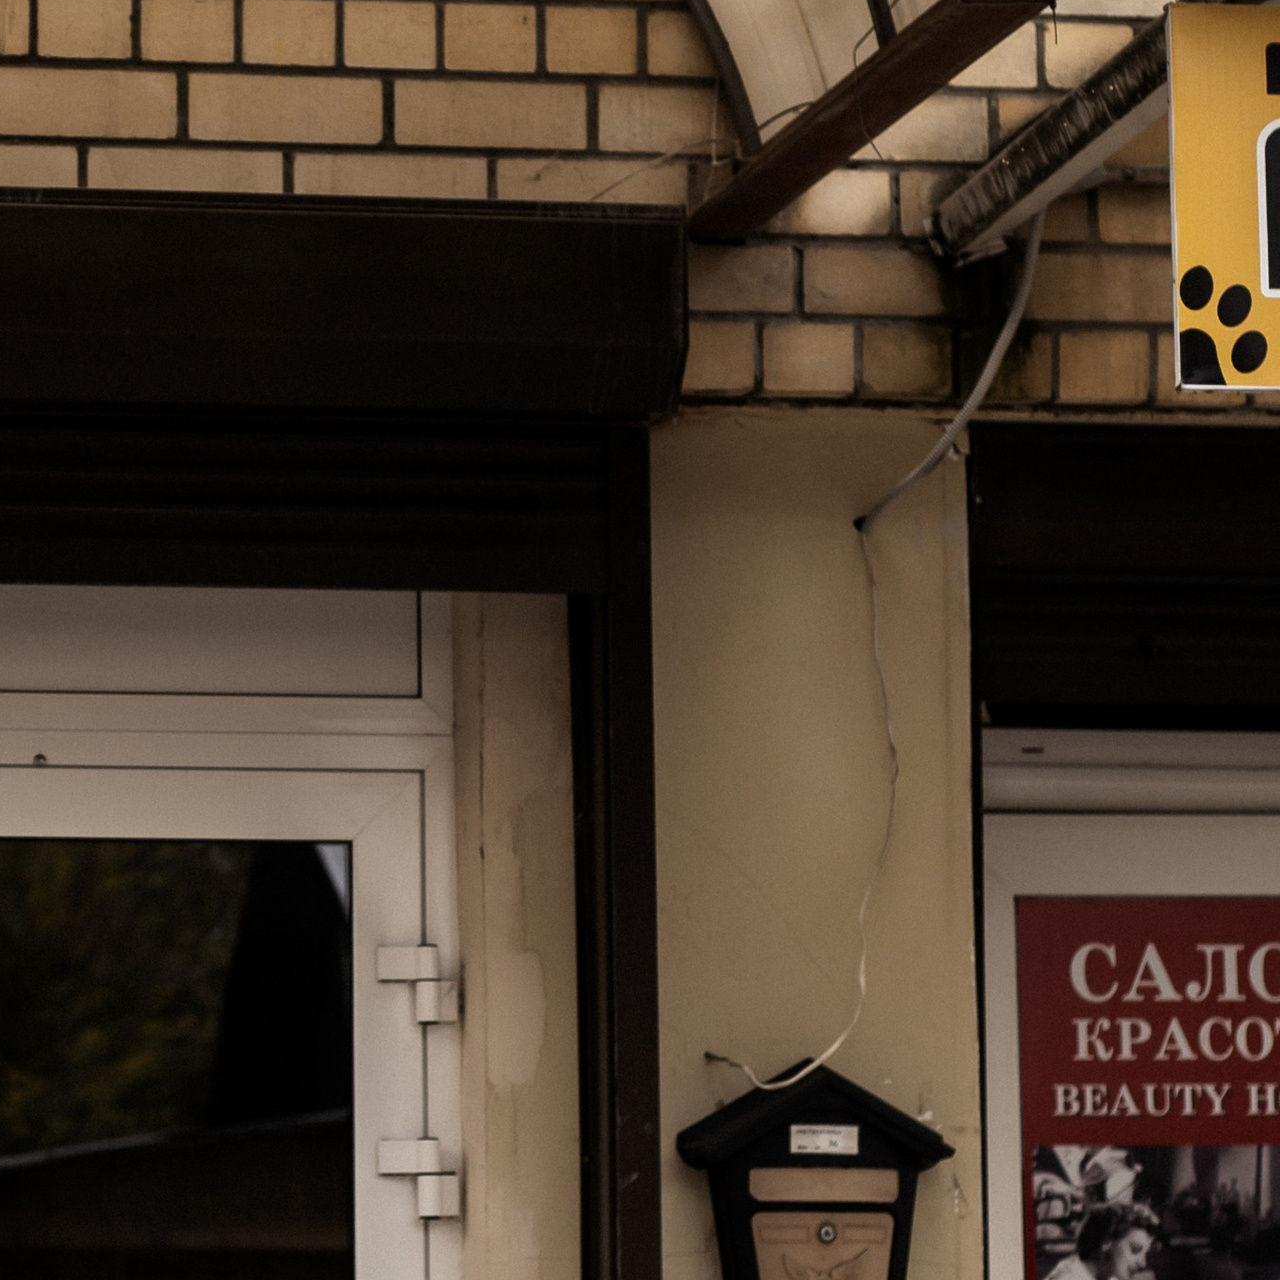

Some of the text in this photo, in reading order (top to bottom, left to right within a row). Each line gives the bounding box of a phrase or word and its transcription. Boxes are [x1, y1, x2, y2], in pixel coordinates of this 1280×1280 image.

[1068, 940, 1280, 1005] САЛО
[1072, 1015, 1280, 1063] КРАСО
[1052, 1081, 1280, 1118] BEAUTY H
